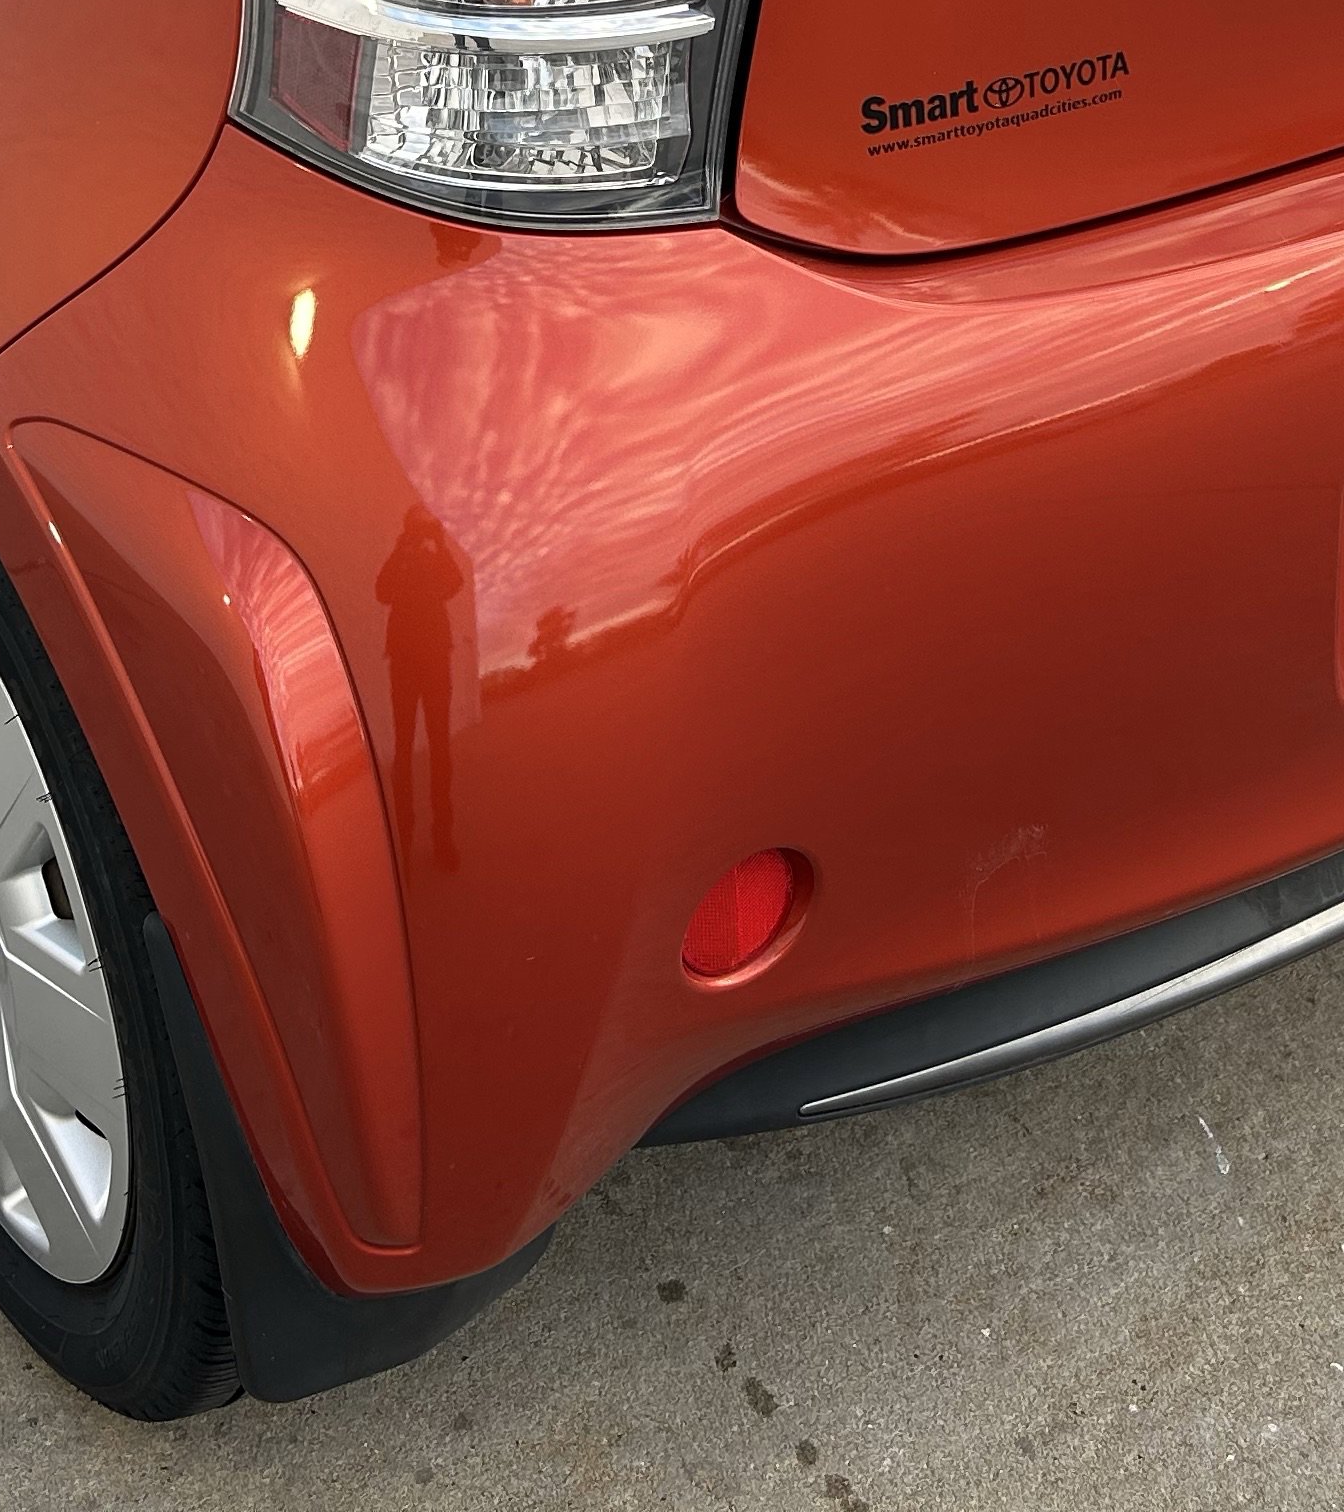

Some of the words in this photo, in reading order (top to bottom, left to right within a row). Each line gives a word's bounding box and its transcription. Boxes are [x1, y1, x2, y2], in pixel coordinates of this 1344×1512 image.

[860, 79, 979, 135] Smart
[1023, 51, 1130, 99] TOYOTA
[867, 88, 1123, 158] www.smarttoyotaquadcities.com
